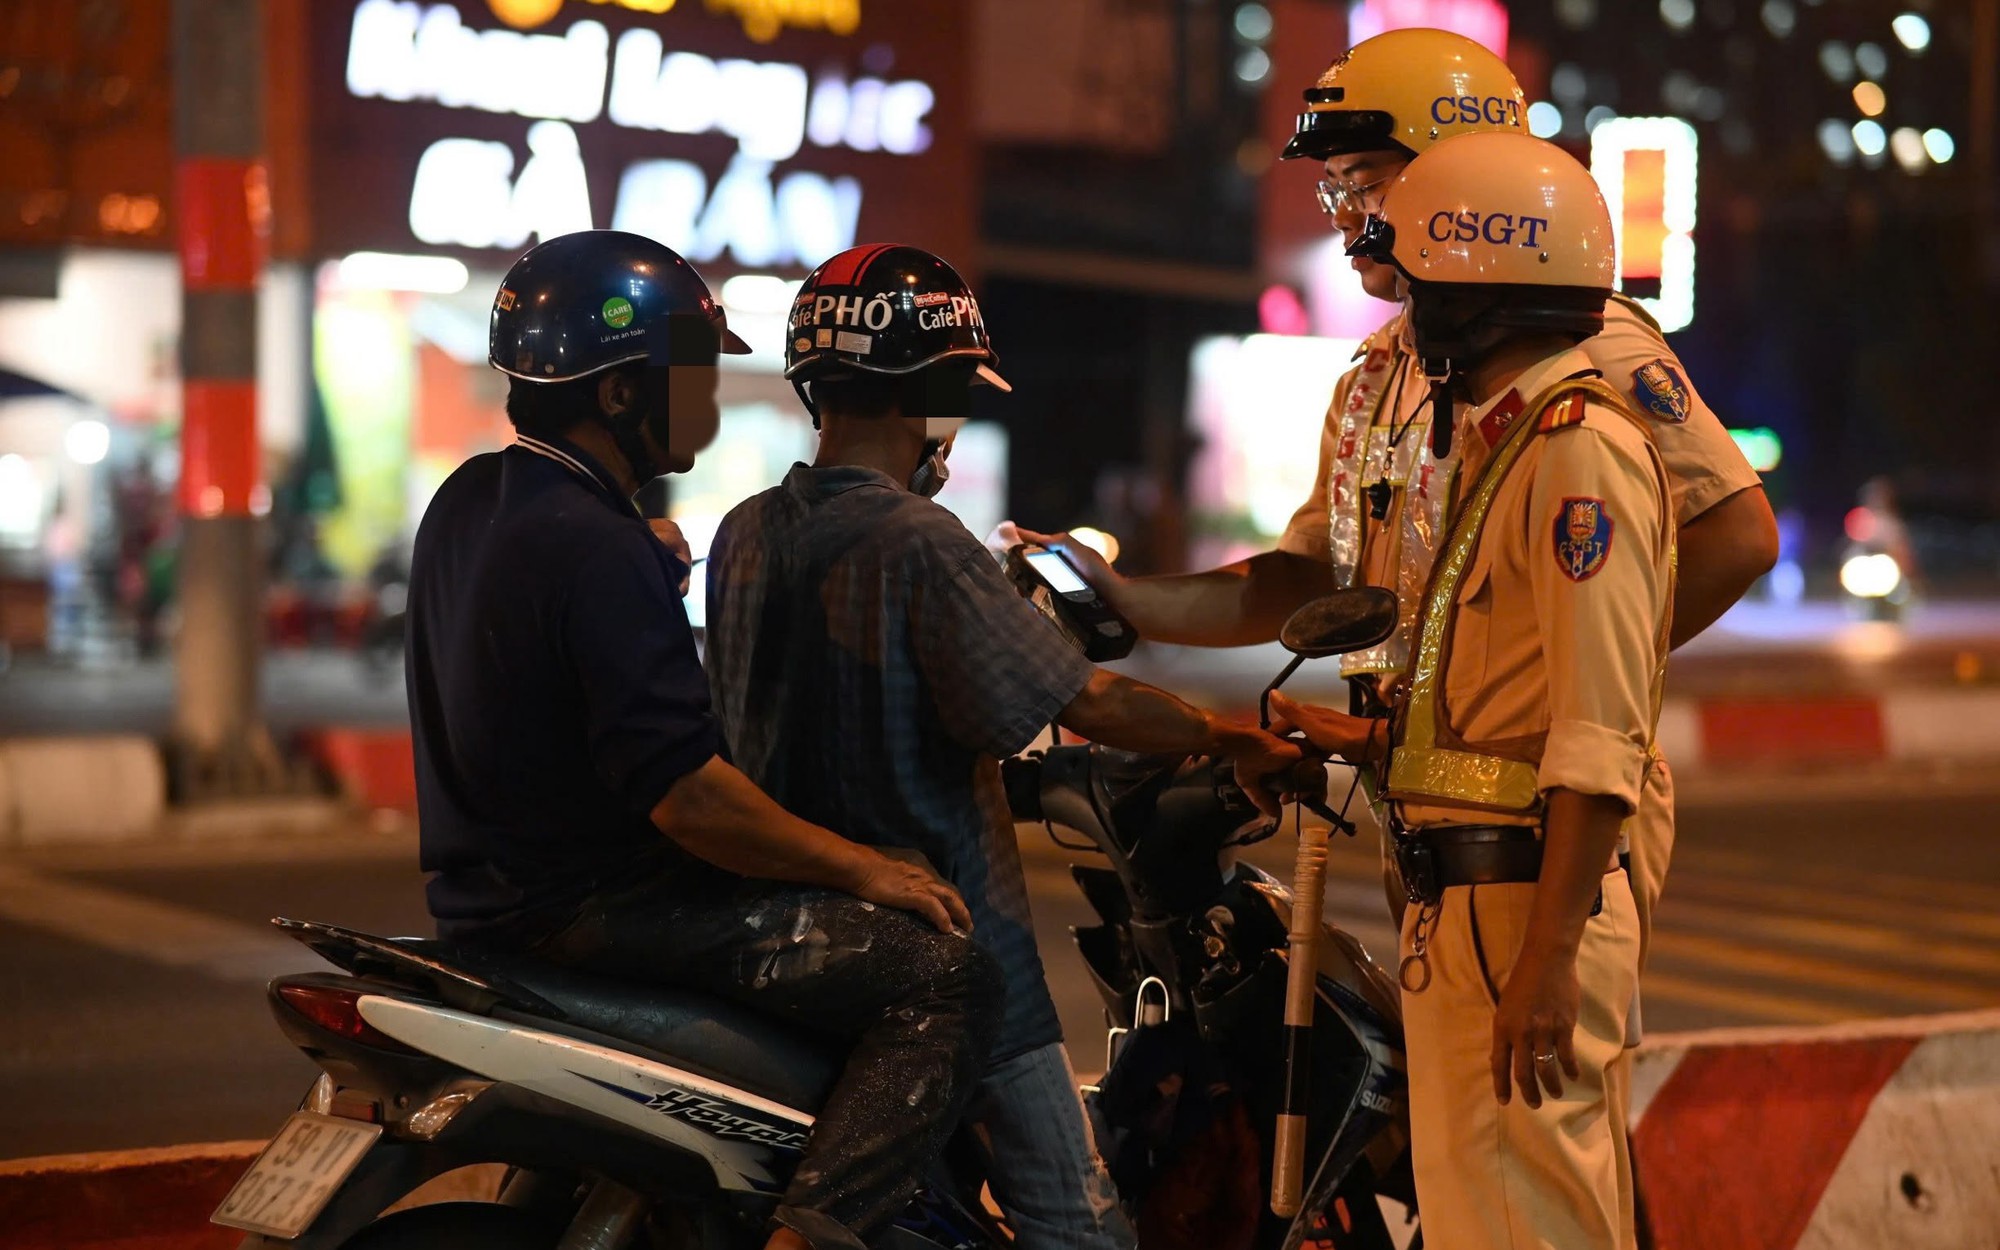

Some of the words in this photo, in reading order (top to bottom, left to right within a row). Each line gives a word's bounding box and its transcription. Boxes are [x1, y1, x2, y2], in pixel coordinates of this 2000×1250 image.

[1431, 96, 1521, 127] CSGT
[1428, 211, 1548, 248] CSGT
[813, 291, 897, 331] PHỐ
[919, 305, 955, 331] Café
[1650, 386, 1686, 410] CSGT
[1560, 541, 1603, 555] CSGT
